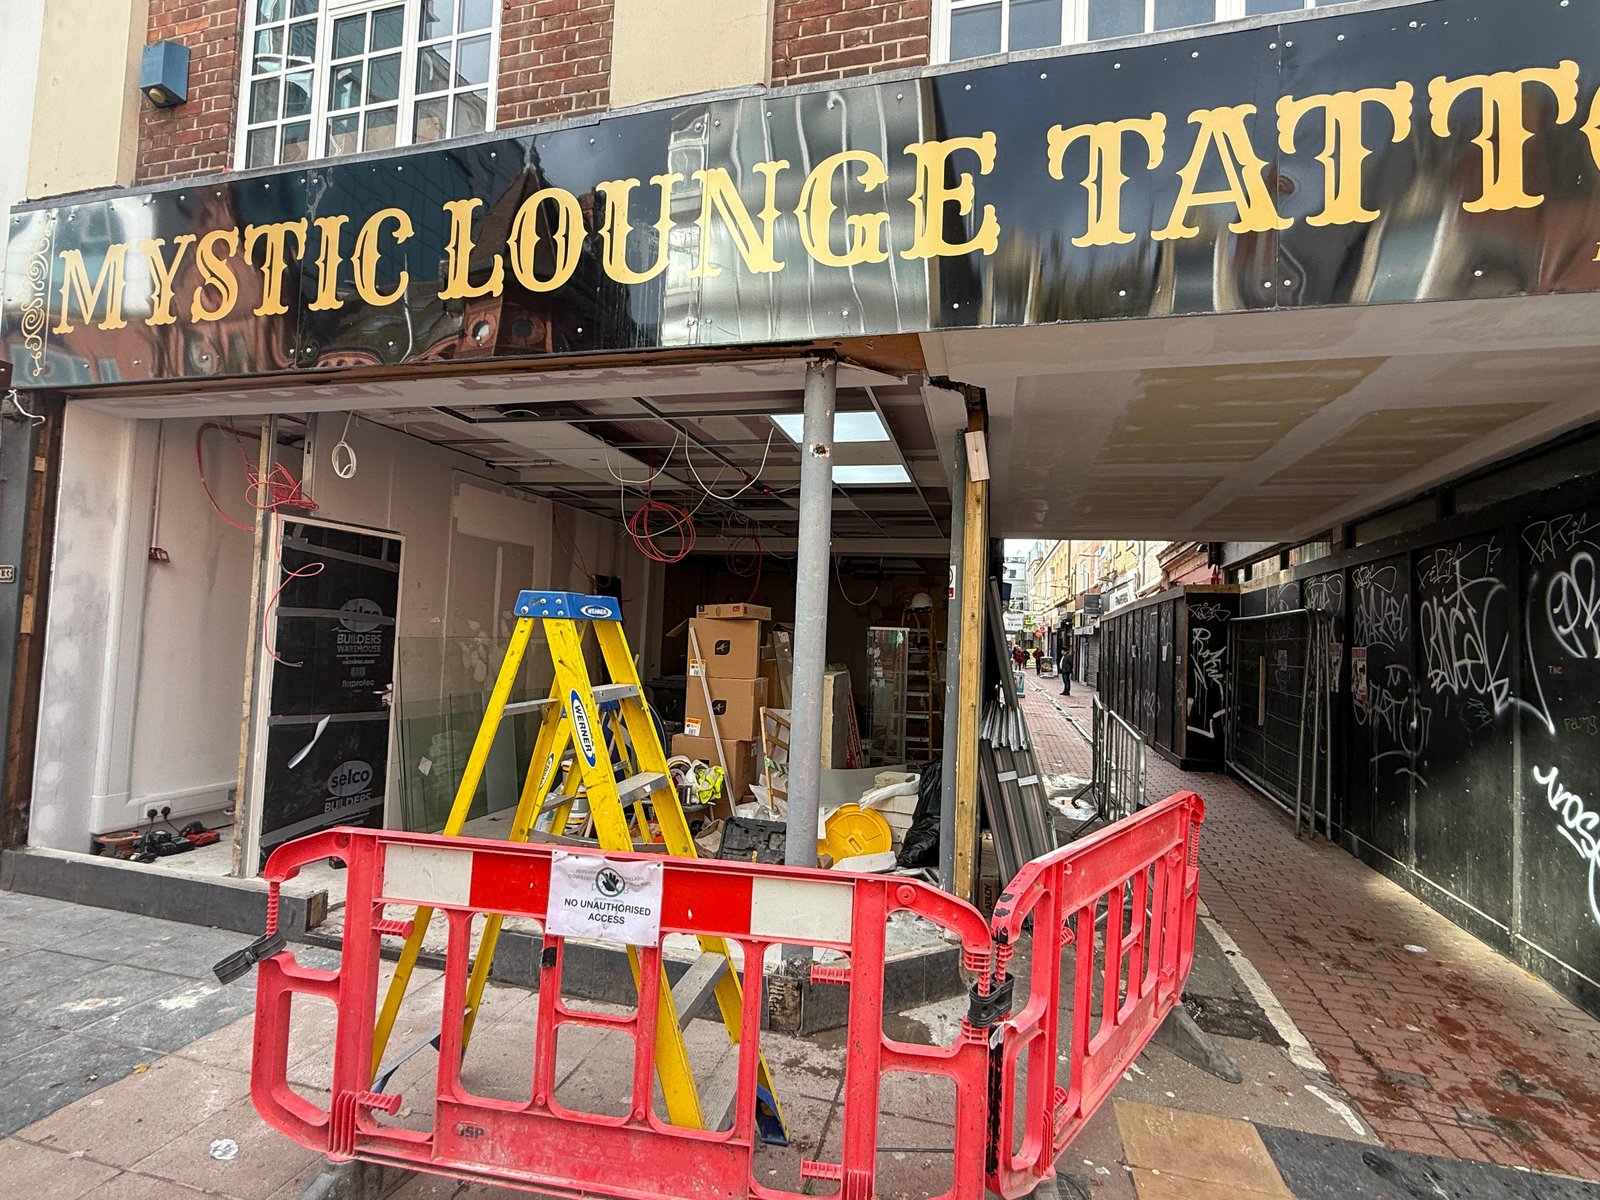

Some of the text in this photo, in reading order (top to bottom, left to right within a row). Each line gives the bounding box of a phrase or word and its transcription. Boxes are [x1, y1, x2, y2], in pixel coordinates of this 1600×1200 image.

[53, 60, 1600, 335] MYSTIC LOUNGE TATT
[337, 633, 382, 645] BUILDERS
[336, 645, 382, 653] WAREHOUSE
[574, 704, 592, 752] WERNER
[330, 769, 370, 788] selco
[564, 898, 651, 917] NO UNAUTHORISED
[587, 912, 625, 925] ACCESS
